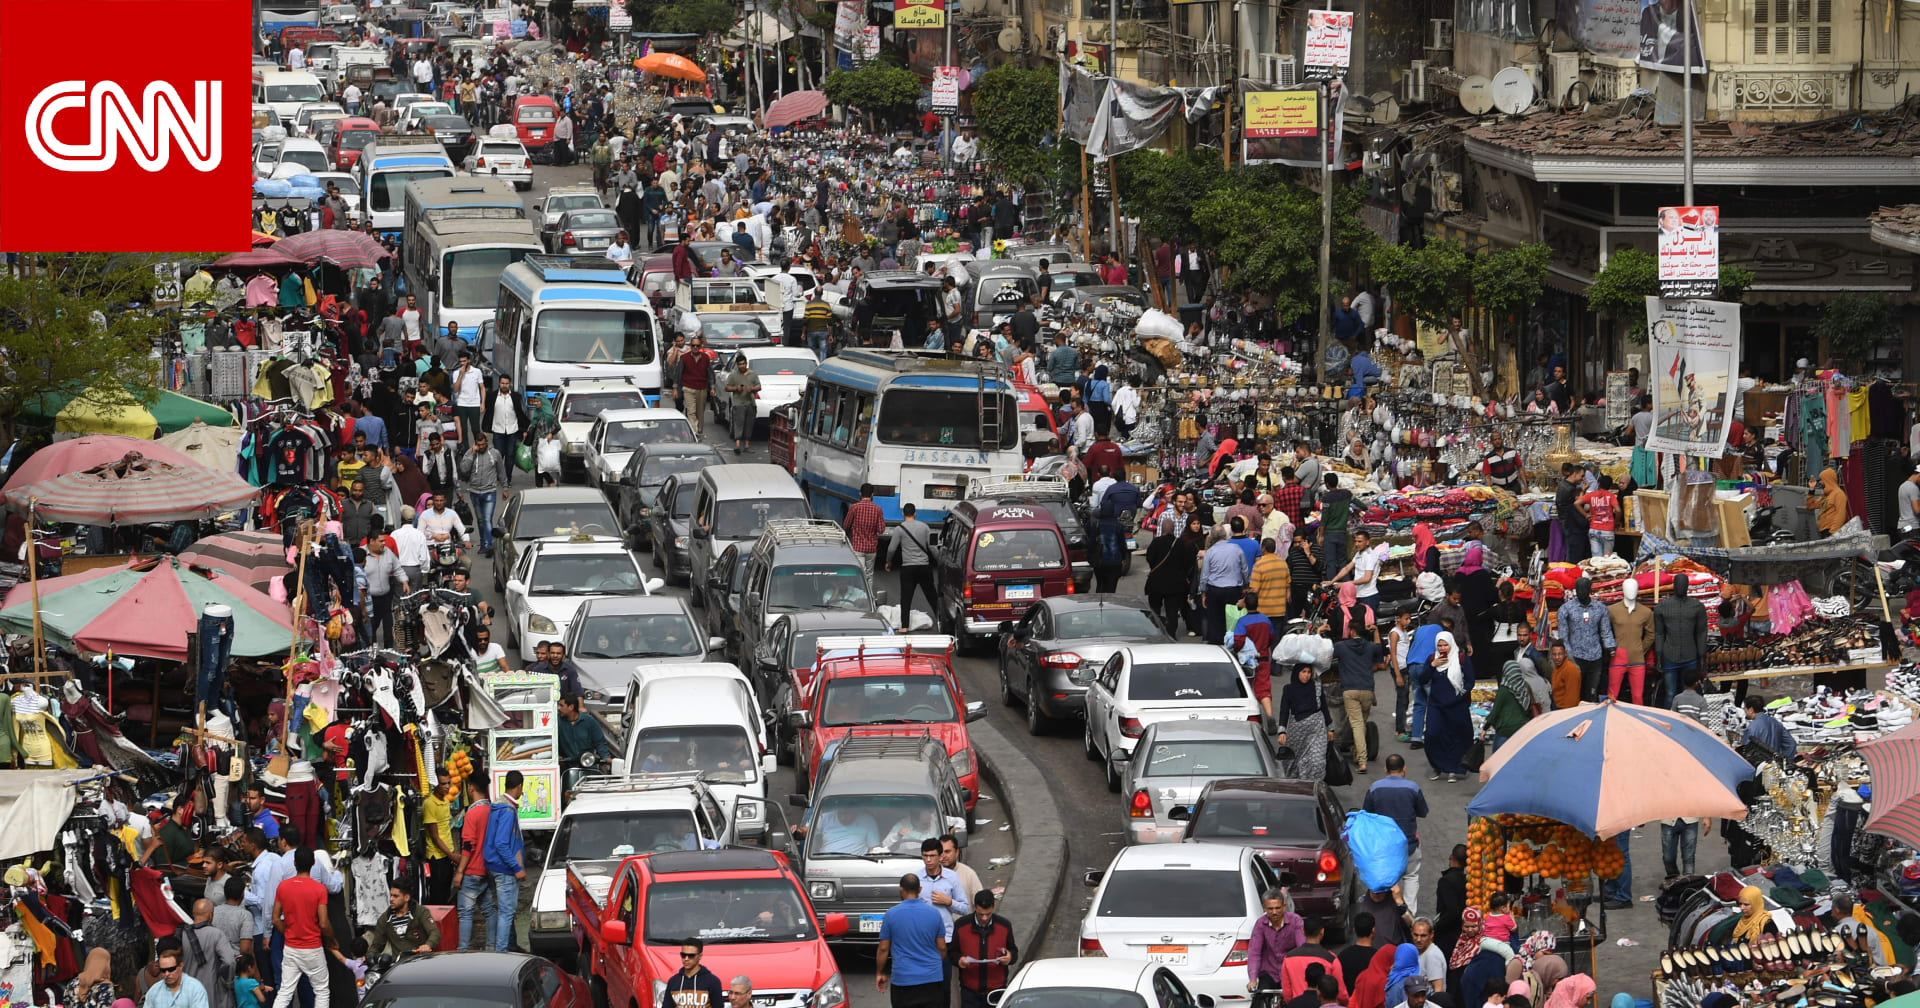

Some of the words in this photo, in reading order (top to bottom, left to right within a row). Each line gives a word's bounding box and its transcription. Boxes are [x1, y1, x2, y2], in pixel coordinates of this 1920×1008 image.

[901, 13, 940, 26] العروسة
[904, 448, 989, 465] HASSAAN
[992, 508, 1008, 519] ABO
[1175, 688, 1203, 697] ESSA
[672, 993, 709, 1006] WORLD
